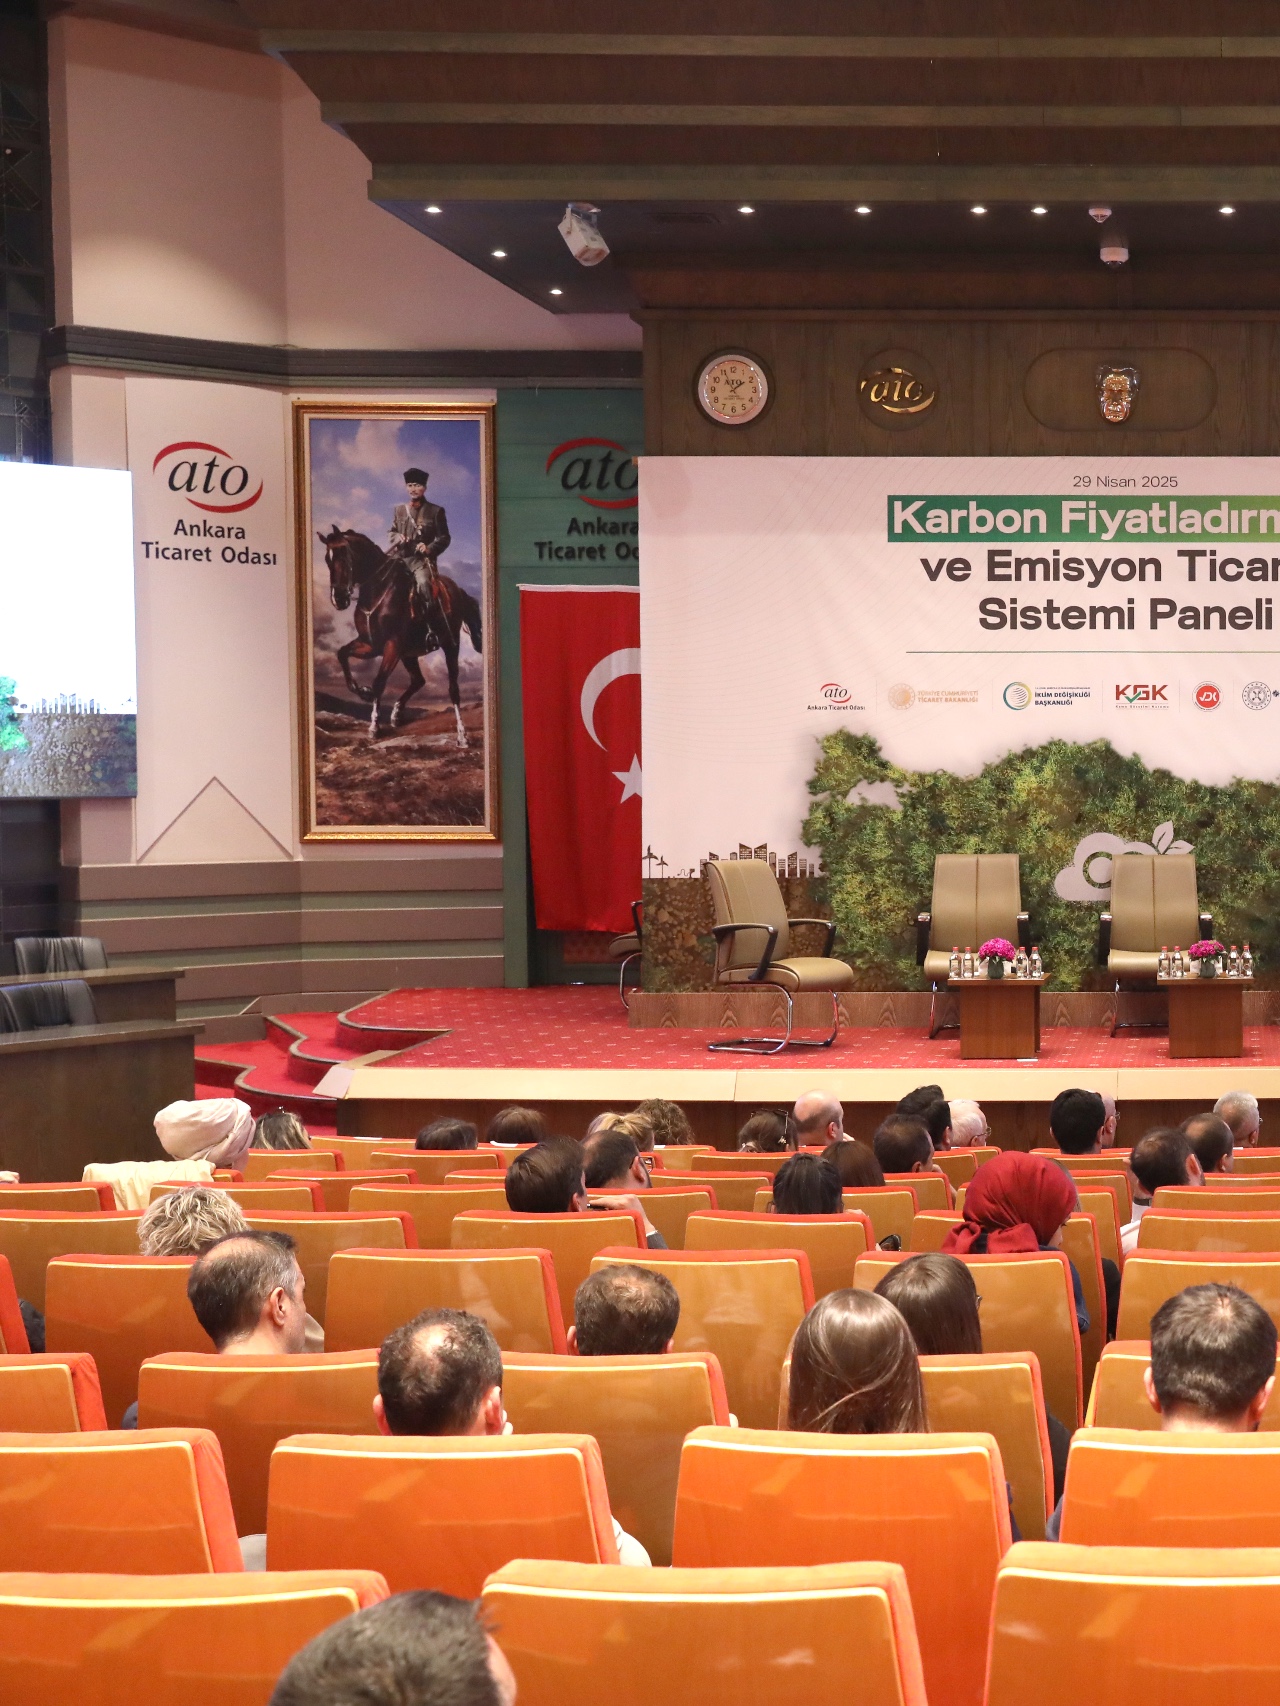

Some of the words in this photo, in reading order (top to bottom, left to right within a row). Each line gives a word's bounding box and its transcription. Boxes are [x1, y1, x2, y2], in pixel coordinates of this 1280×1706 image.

[168, 455, 249, 496] ato
[561, 450, 638, 491] ato
[1073, 476, 1092, 488] 29
[1096, 476, 1136, 488] Nisan
[1141, 476, 1178, 488] 2025
[567, 517, 638, 536] Ankara
[893, 500, 1047, 534] Karbon
[174, 519, 246, 540] Ankara
[141, 541, 212, 562] Ticaret
[221, 546, 277, 565] Odası
[534, 541, 606, 561] Ticaret
[919, 557, 972, 582] ve
[987, 549, 1162, 589] Emisyon
[978, 597, 1135, 631] Sistemi
[1150, 598, 1273, 630] Paneli
[824, 687, 848, 698] ato
[1115, 684, 1169, 701] KGK
